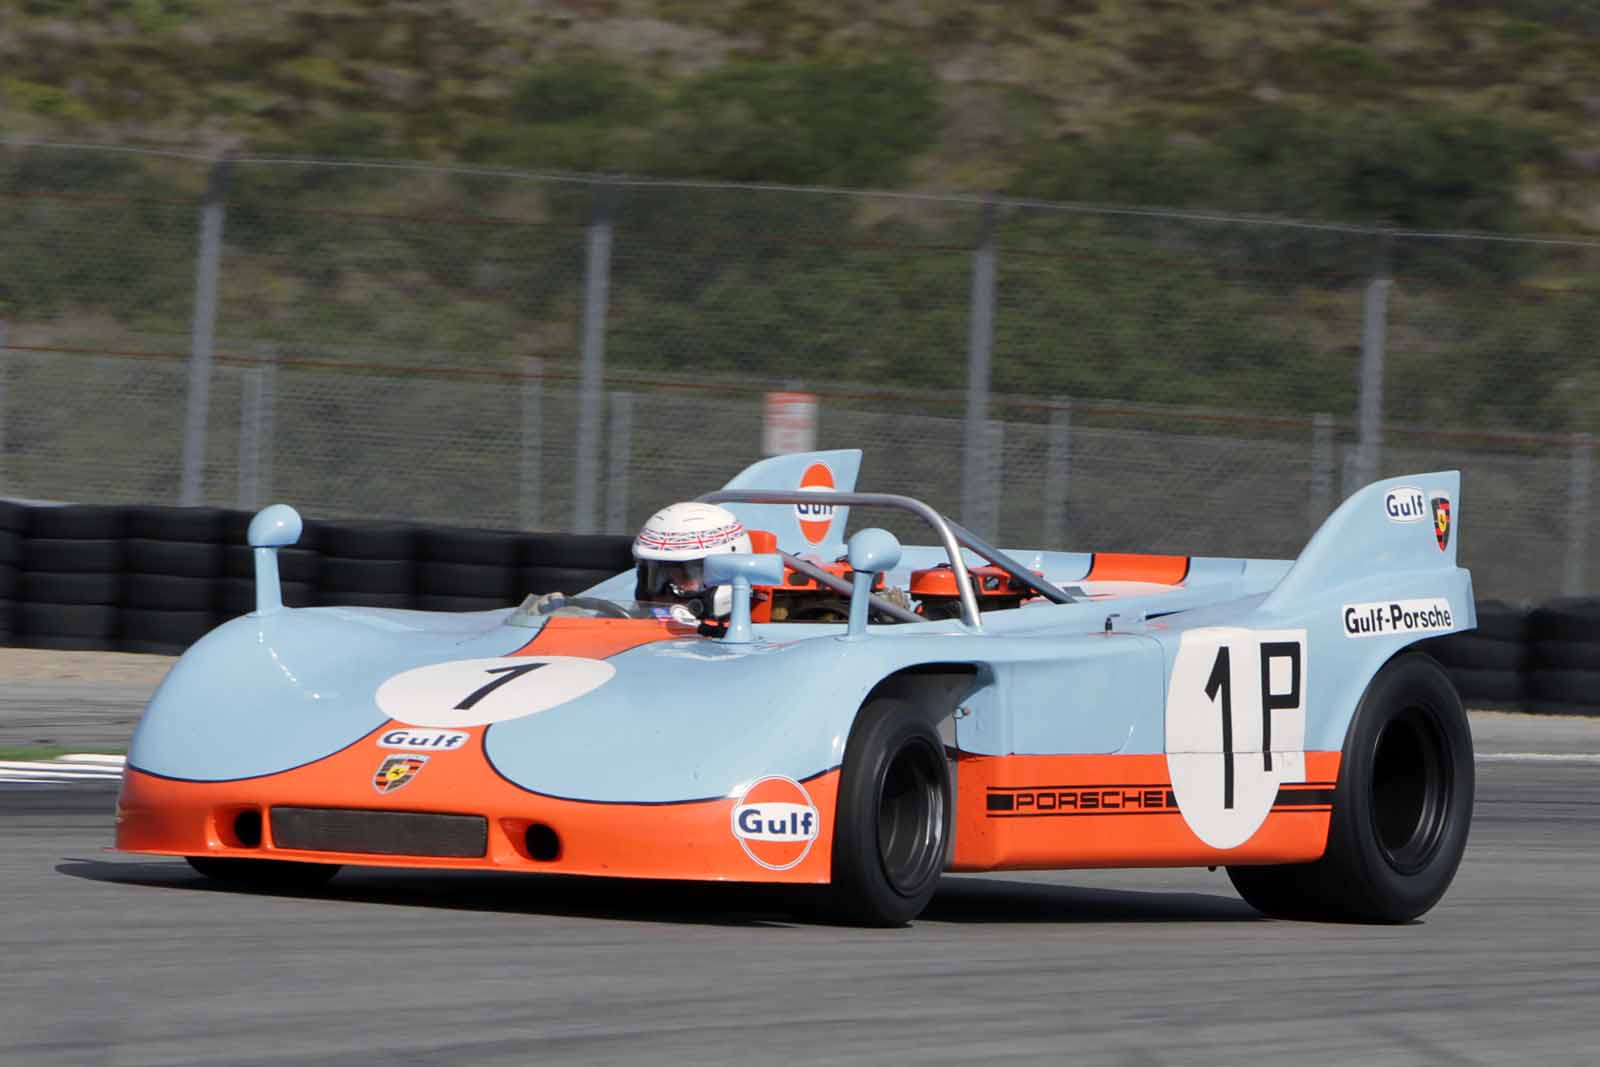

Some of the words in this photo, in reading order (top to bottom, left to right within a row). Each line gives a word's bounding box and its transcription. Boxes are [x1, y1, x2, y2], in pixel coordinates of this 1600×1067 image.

[1386, 494, 1424, 517] Gulf
[1345, 604, 1452, 634] Gulf-Porsche
[453, 662, 552, 710] 1
[383, 731, 463, 747] Gulf
[1016, 790, 1163, 810] PORSCHE
[738, 808, 813, 835] Gulf
